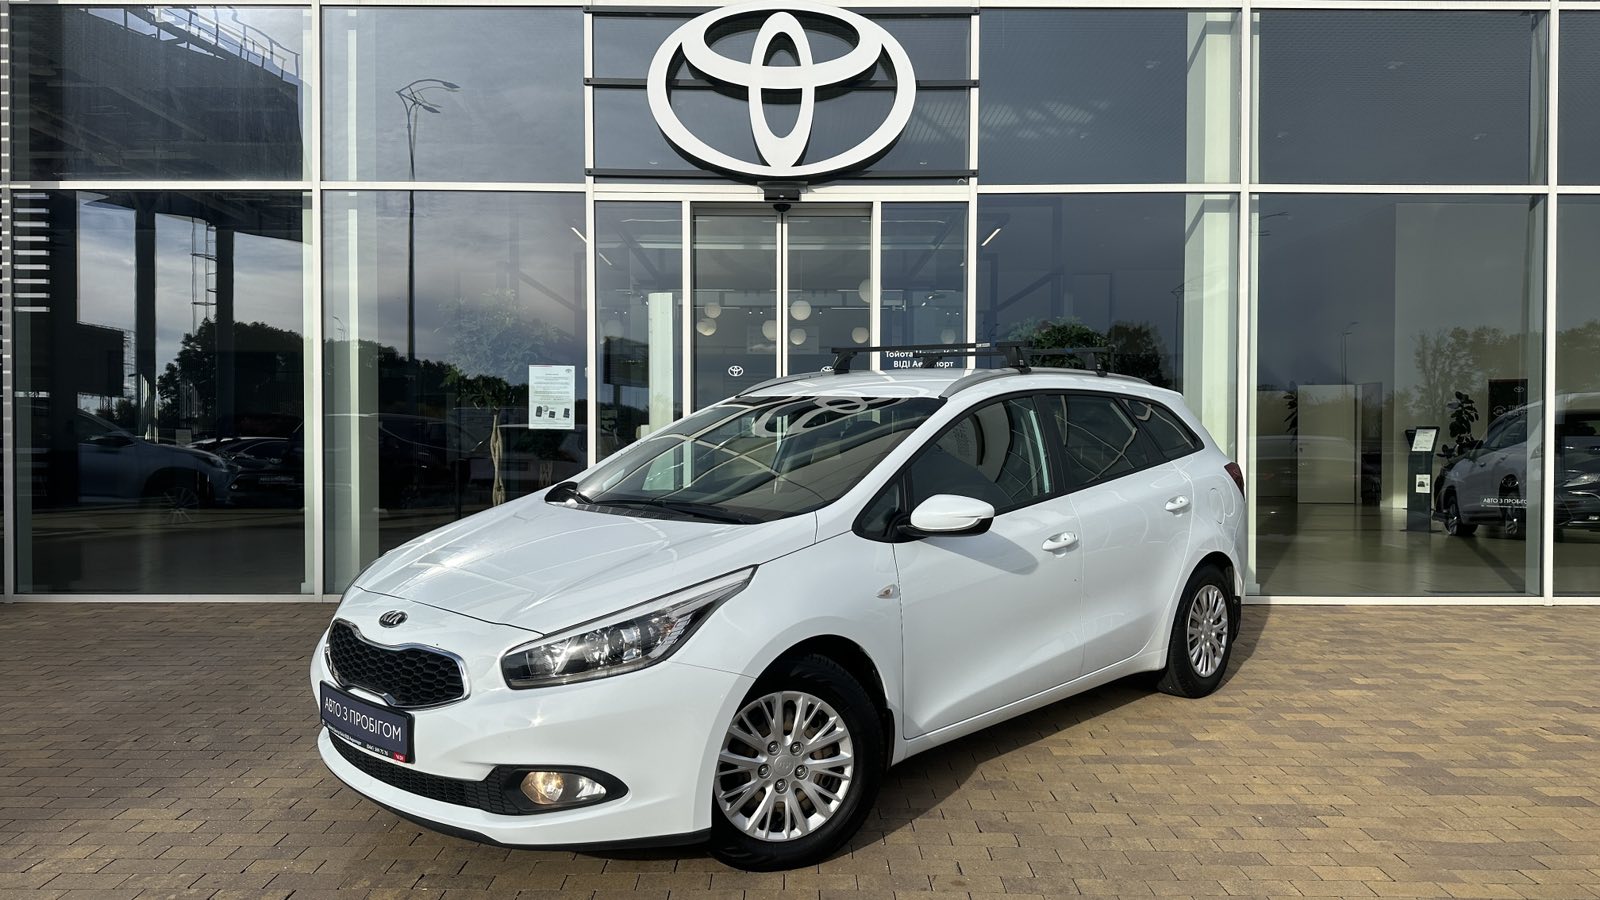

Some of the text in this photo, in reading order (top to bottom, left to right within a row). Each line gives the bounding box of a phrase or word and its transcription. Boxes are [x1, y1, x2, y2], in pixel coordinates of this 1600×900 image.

[885, 350, 913, 358] Тойота
[912, 361, 954, 369] Аеорт
[382, 611, 403, 625] KIA
[324, 696, 341, 718] АВТО
[350, 710, 401, 741] ПРОБІГОМ
